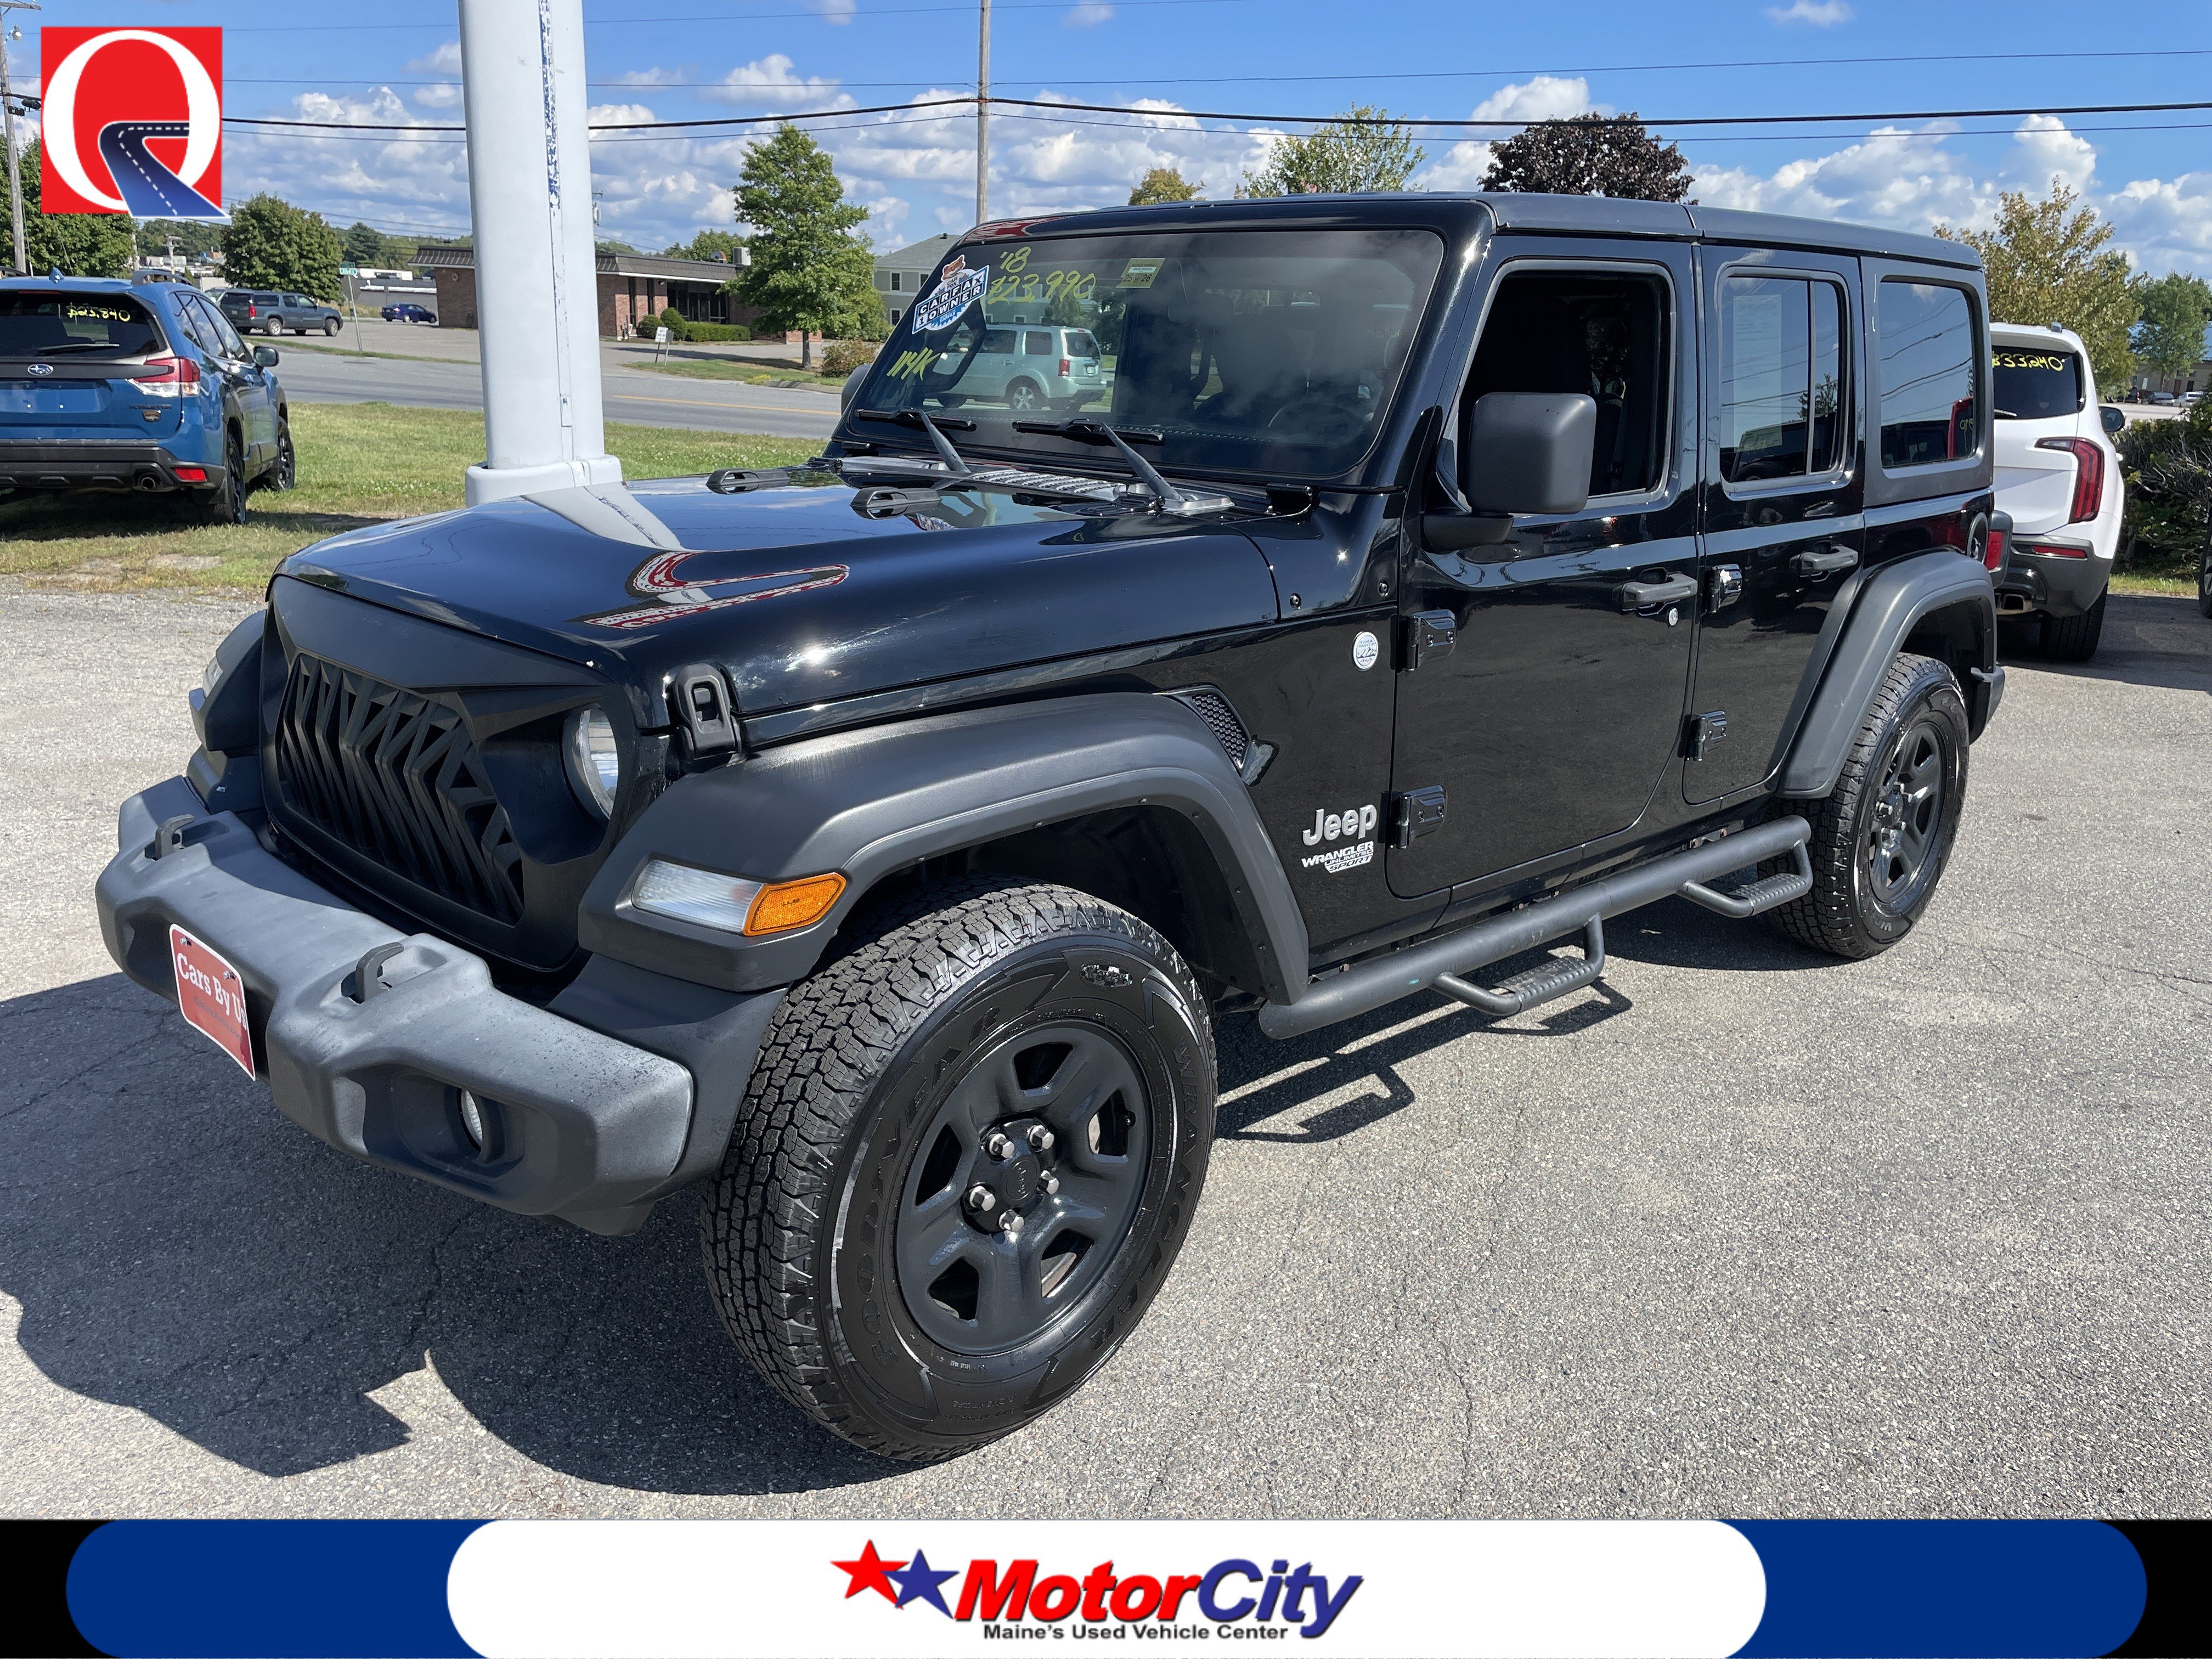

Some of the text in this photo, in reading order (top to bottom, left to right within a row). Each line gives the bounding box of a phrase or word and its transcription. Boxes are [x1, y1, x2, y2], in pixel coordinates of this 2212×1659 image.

[1000, 246, 1031, 273] '18
[919, 275, 983, 314] CARFAX
[947, 276, 958, 285] CAR
[987, 270, 1096, 306] $23,990
[918, 286, 980, 326] 1 OWNER
[886, 347, 941, 381] 114K
[1302, 804, 1377, 846] Jeep
[1301, 841, 1374, 867] WRANGLER
[1324, 849, 1374, 866] UNLIMITED
[1328, 856, 1370, 871] SPORT
[177, 952, 212, 996] Cars
[212, 975, 230, 1015] By
[232, 992, 247, 1030] Us
[1091, 1036, 1199, 1351] WRANGLER
